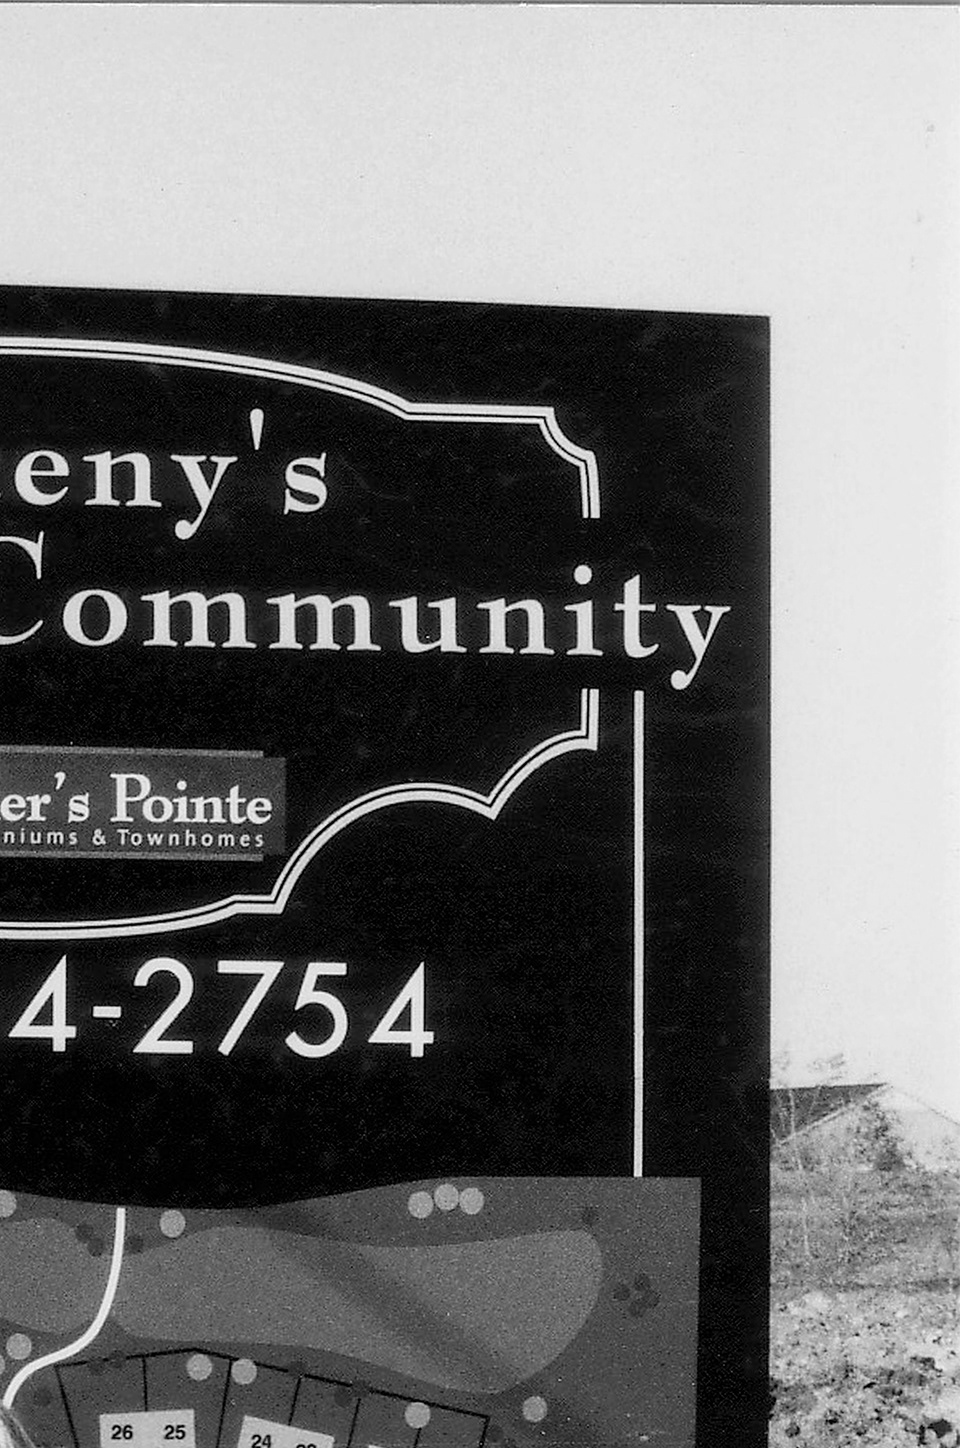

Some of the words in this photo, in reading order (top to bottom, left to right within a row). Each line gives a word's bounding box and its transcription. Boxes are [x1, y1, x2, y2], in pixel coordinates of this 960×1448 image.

[109, 773, 273, 825] Pointe
[92, 828, 107, 846] &
[116, 828, 264, 848] Townhomes
[110, 1424, 134, 1441] 26
[163, 1424, 186, 1441] 25
